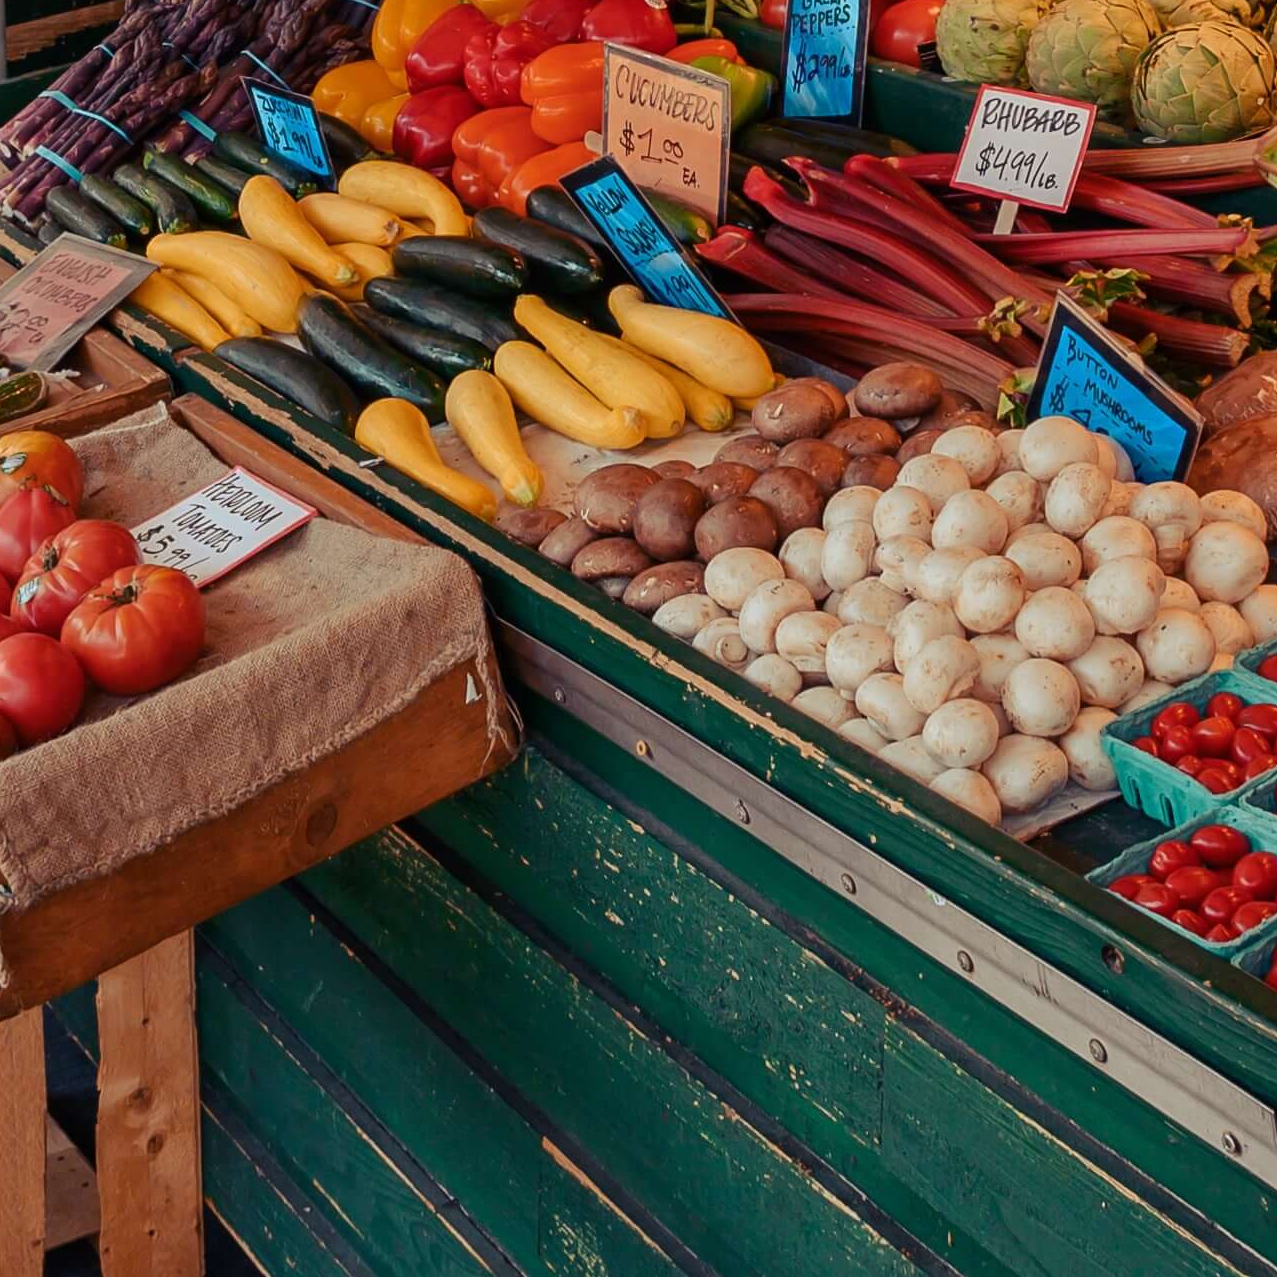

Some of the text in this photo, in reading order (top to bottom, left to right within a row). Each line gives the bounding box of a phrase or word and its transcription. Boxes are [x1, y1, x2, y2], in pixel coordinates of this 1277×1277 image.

[791, 4, 852, 36] PEPPERS
[615, 63, 721, 133] CUCUMBERS
[980, 97, 1082, 137] RHUBARB
[681, 168, 701, 189] EA.
[1066, 334, 1119, 390] BUTTON
[1083, 376, 1154, 446] MUSHROOMS
[171, 503, 244, 554] TOMATOES
[200, 472, 284, 532] HEIRLOOM
